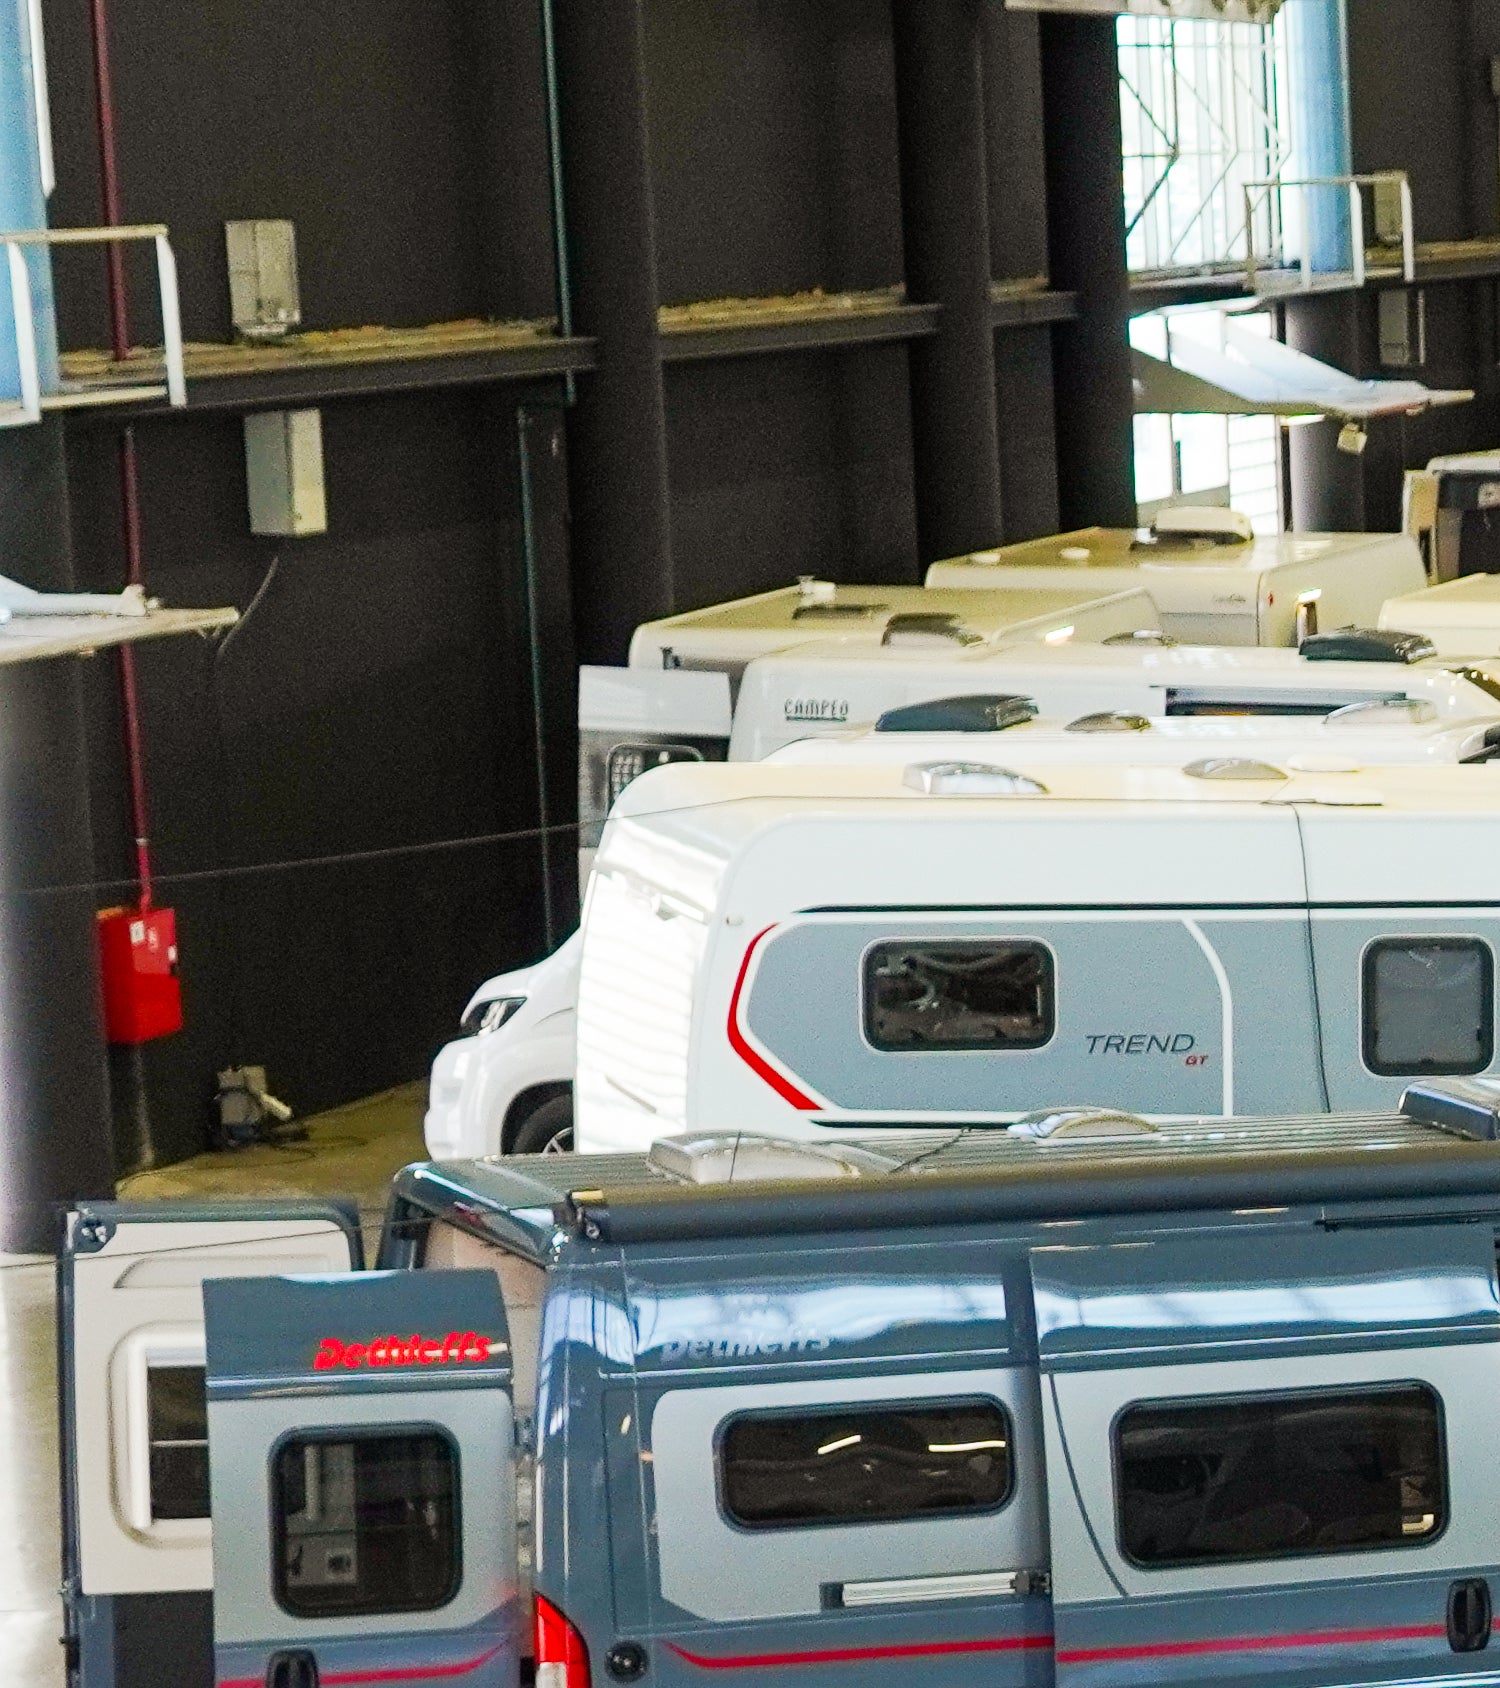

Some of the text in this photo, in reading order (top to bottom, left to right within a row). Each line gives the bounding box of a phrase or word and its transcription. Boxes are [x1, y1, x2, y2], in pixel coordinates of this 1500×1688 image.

[783, 698, 849, 719] CAMPEO
[1084, 1034, 1196, 1055] TREND
[1185, 1054, 1209, 1067] GT
[313, 1331, 492, 1371] Dethleffs
